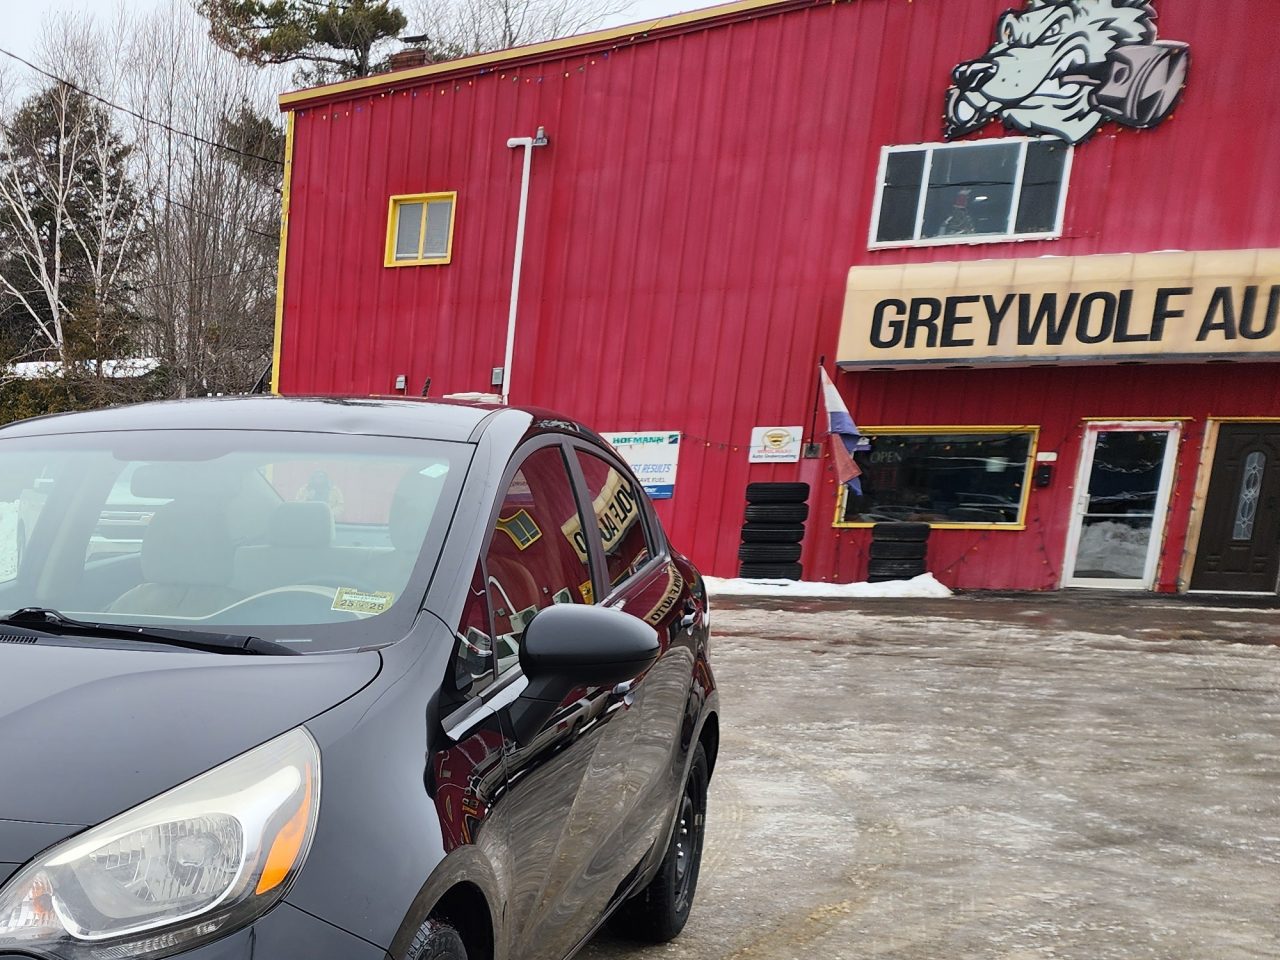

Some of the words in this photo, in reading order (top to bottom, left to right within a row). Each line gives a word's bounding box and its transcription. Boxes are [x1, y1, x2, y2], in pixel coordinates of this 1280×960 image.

[869, 286, 1194, 349] GREYWOLF
[612, 436, 664, 444] HOFMANN
[871, 451, 902, 463] OPEN
